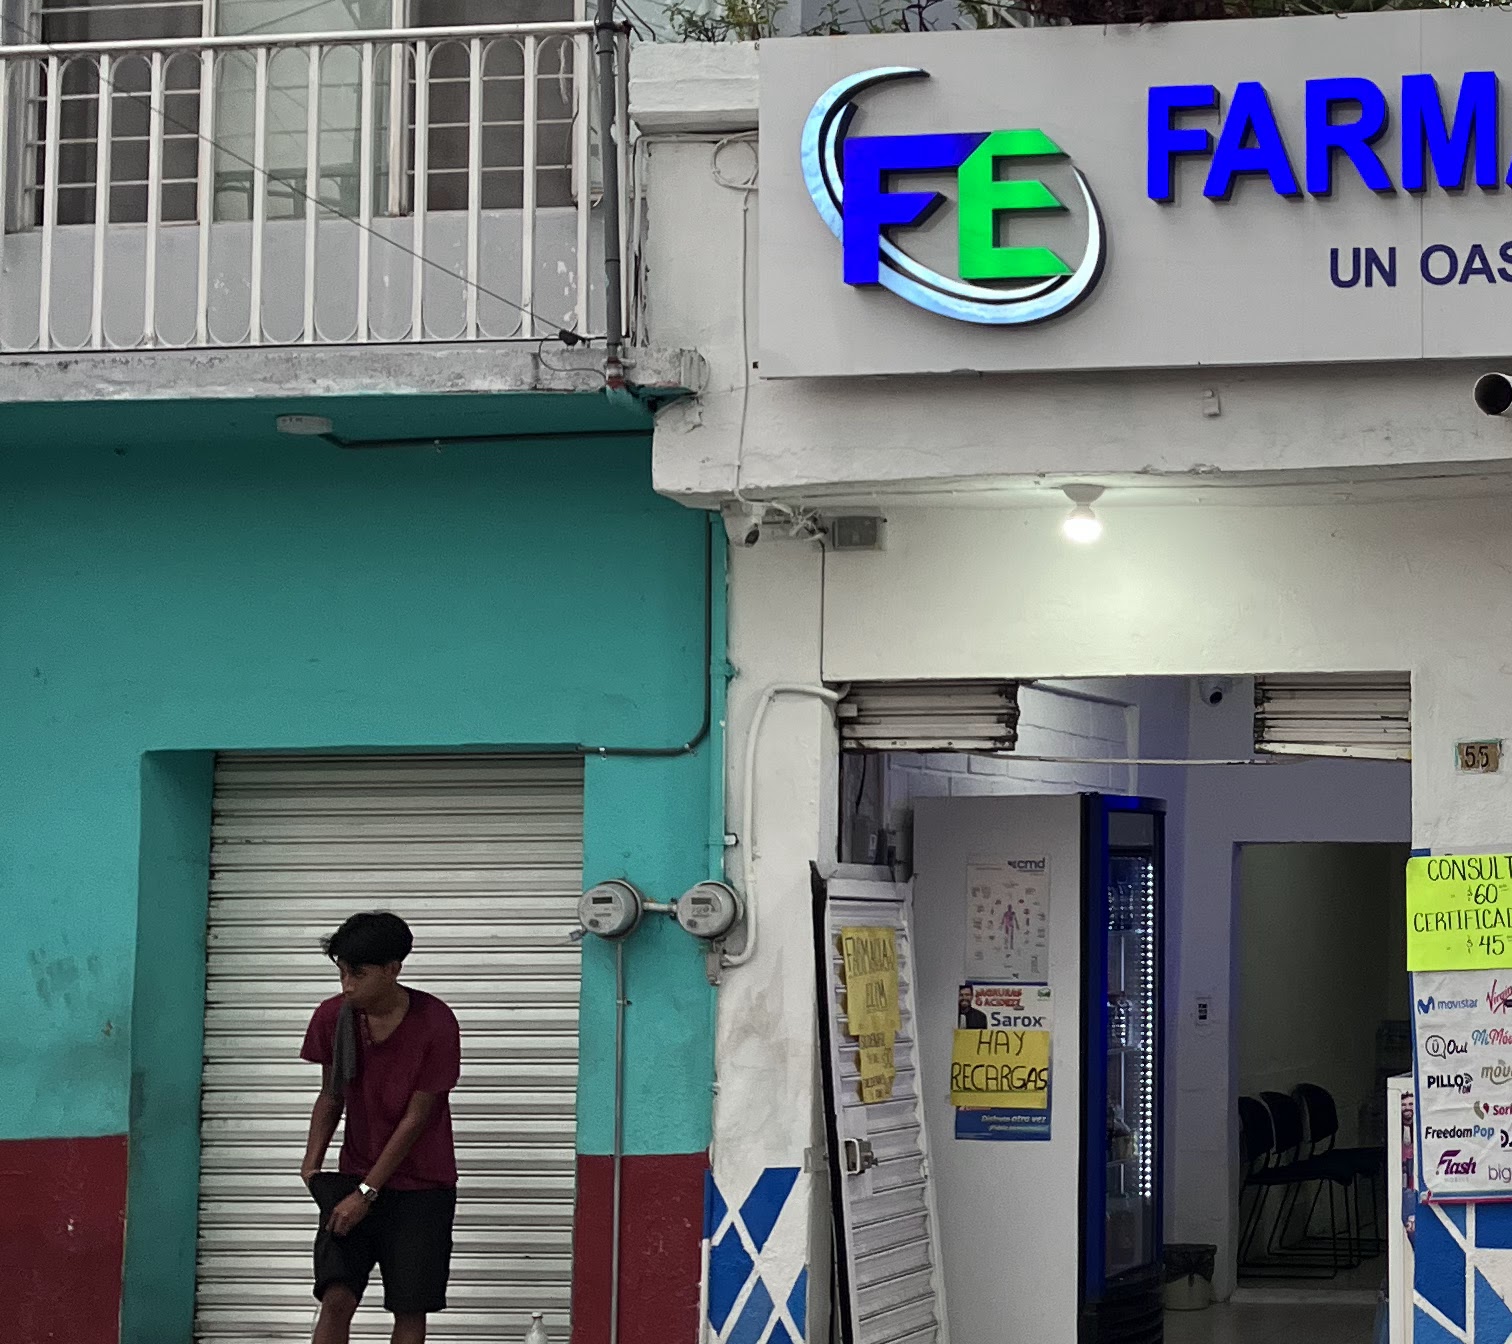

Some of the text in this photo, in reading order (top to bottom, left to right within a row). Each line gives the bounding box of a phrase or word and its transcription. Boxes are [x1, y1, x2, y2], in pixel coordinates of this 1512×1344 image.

[1330, 246, 1397, 289] UN
[1465, 745, 1489, 768] 55
[1017, 857, 1046, 869] cmd
[1437, 997, 1478, 1010] movistar
[991, 1012, 1043, 1028] Sarox
[977, 1030, 1026, 1057] HAY
[950, 1061, 1048, 1092] RECARGAS
[1425, 1124, 1495, 1140] FreedomPop
[1436, 1149, 1477, 1176] Flash
